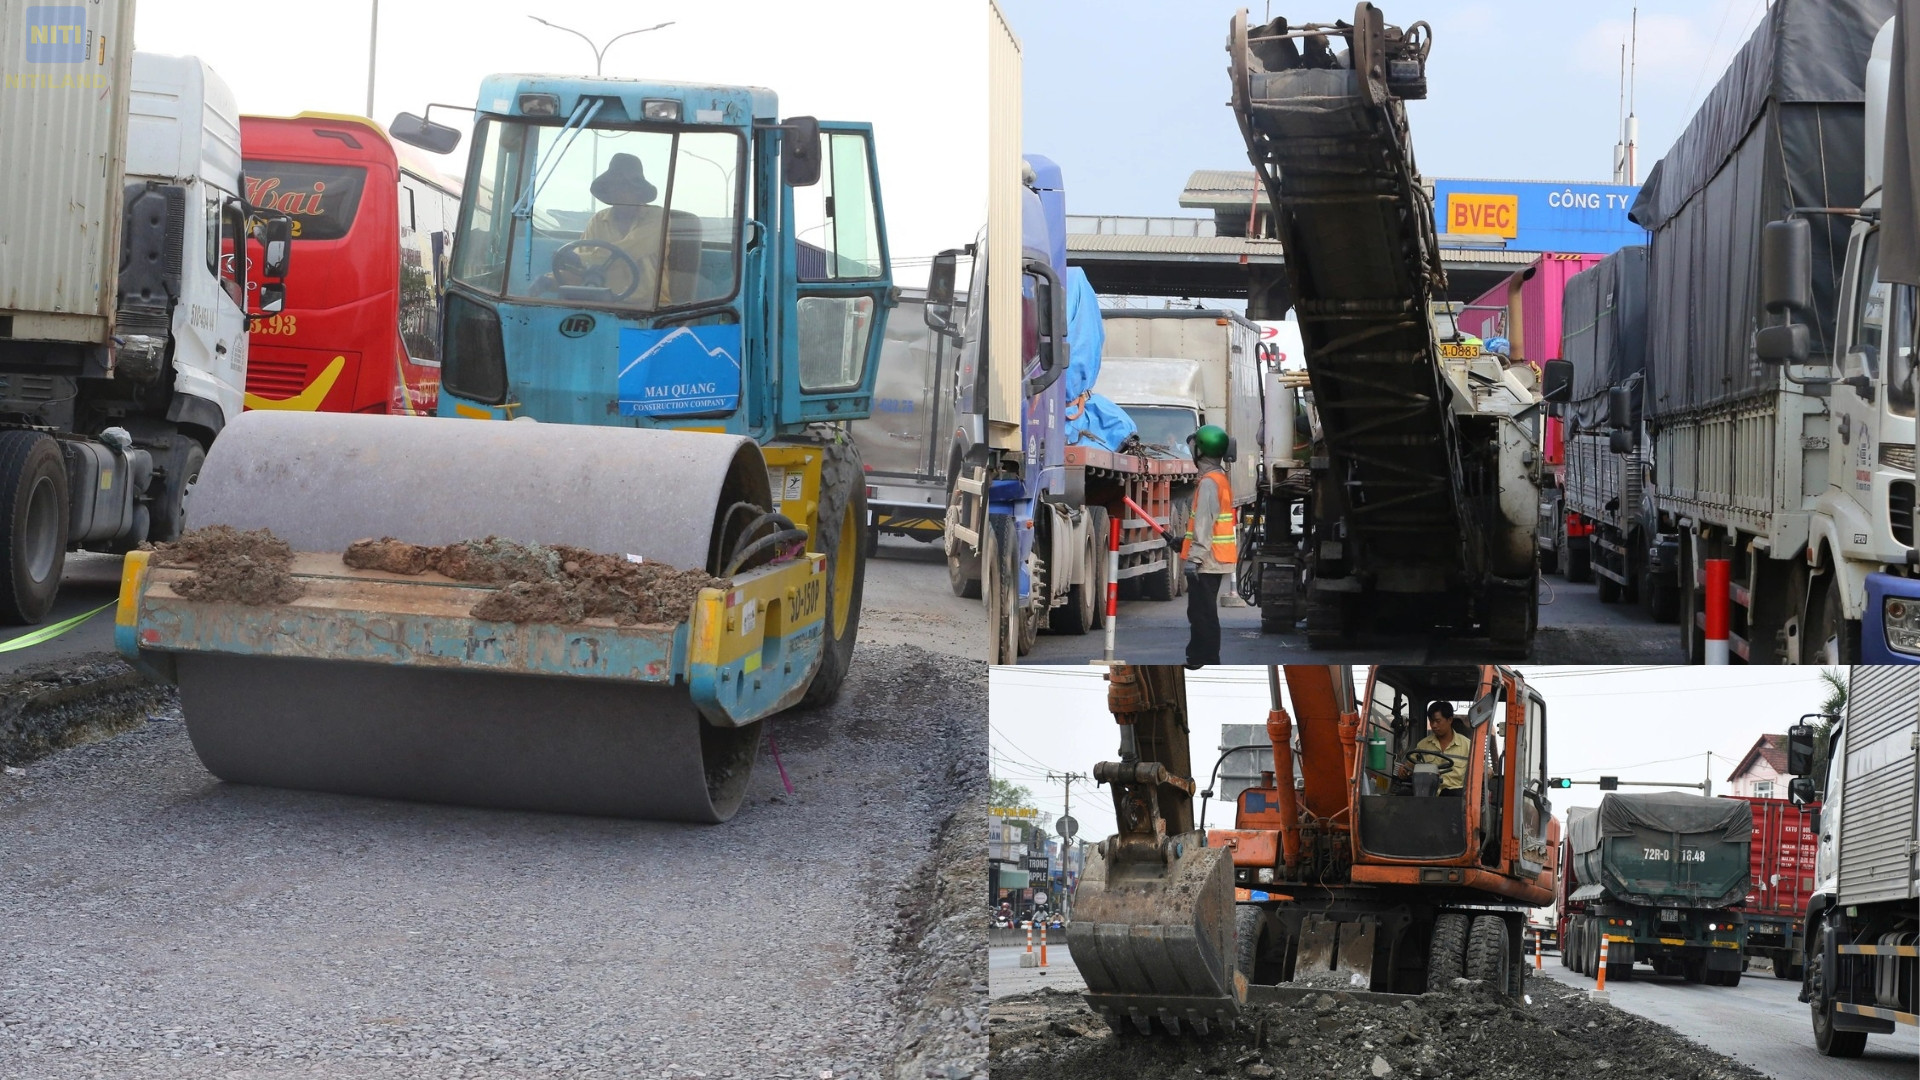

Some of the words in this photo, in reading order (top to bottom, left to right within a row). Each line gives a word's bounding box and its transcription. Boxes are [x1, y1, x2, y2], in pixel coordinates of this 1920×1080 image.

[1548, 189, 1600, 209] CÔNG
[1606, 194, 1629, 209] TY
[1454, 203, 1510, 229] BVEC
[645, 386, 668, 398] MAI
[671, 383, 716, 397] QUANG
[633, 402, 689, 411] CONSTRUCTION
[690, 398, 725, 408] COMPANY
[1644, 848, 1669, 861] 72R-0
